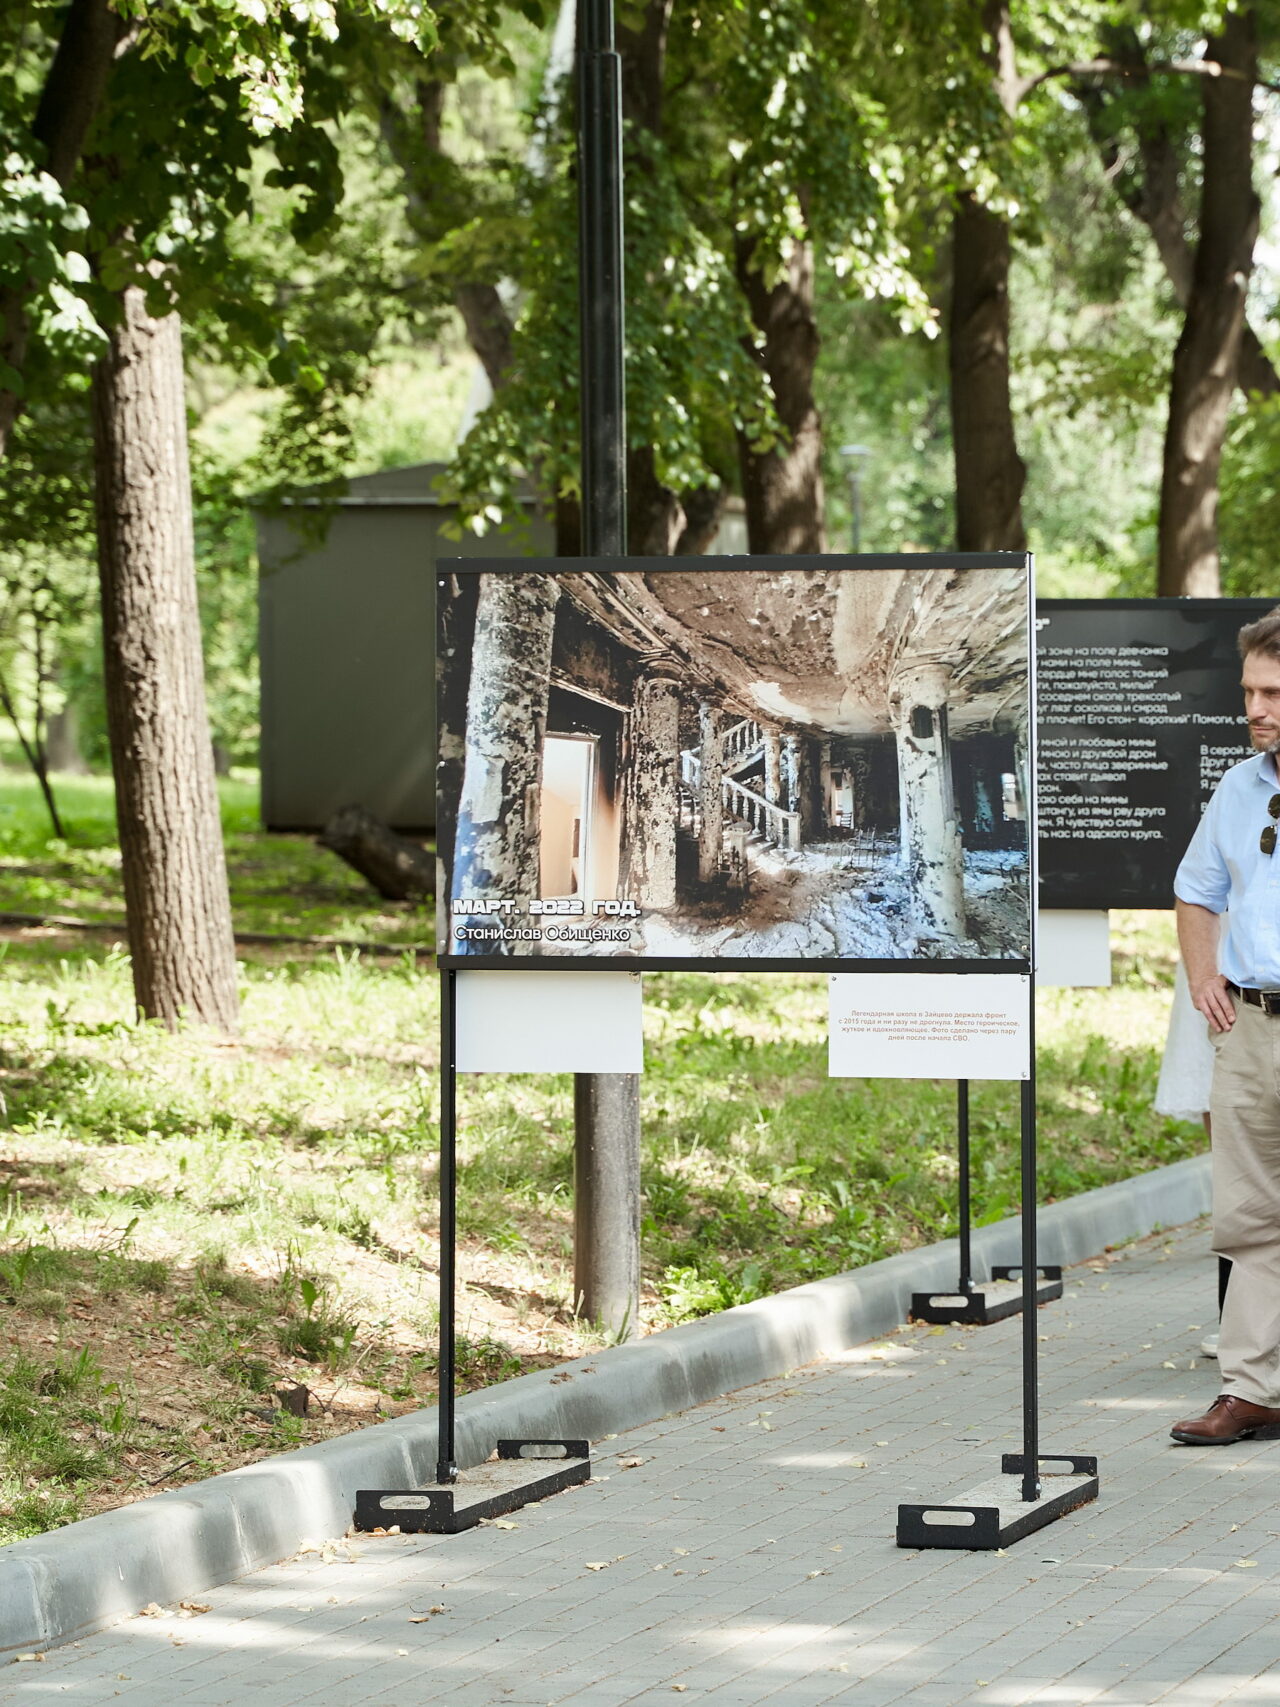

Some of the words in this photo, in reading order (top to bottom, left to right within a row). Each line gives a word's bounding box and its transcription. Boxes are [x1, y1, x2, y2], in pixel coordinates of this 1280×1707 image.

[1048, 647, 1073, 655] зоне
[1075, 647, 1089, 655] на
[1090, 647, 1116, 655] поле
[1118, 647, 1169, 656] девчонка
[1040, 659, 1068, 667] нами
[1070, 659, 1083, 667] на
[1085, 659, 1111, 667] поле
[1113, 659, 1142, 667] мины.
[1100, 670, 1130, 678] голос
[1132, 669, 1169, 678] тонкий
[1053, 681, 1118, 691] пожалуйста,
[1039, 693, 1091, 702] соседнем
[1092, 693, 1124, 701] окопе
[1127, 692, 1181, 702] трехсотый
[1074, 704, 1122, 712] осколков
[1132, 705, 1168, 714] смрад
[1087, 714, 1105, 724] Его
[1192, 714, 1235, 724] Помоги,
[1040, 737, 1068, 747] мной
[1078, 737, 1127, 747] любовью
[1128, 739, 1156, 747] мины
[1041, 750, 1071, 758] мною
[1072, 750, 1079, 758] и
[1081, 749, 1127, 760] дружбой
[1128, 751, 1156, 760] дрон
[1210, 745, 1244, 757] серой
[1050, 761, 1081, 769] часто
[1083, 762, 1109, 770] лица
[1200, 757, 1225, 768] Друг
[1053, 773, 1088, 781] ставит
[1089, 773, 1126, 782] дьявол
[1058, 795, 1083, 804] себя
[1085, 796, 1099, 804] на
[1113, 808, 1132, 817] рву
[1134, 808, 1166, 817] друга
[1056, 817, 1064, 826] Я
[1065, 819, 1114, 828] чувствую
[1115, 819, 1143, 827] силы
[1050, 830, 1071, 838] нас
[1086, 830, 1129, 839] адского
[1130, 831, 1163, 840] круга.
[453, 900, 519, 914] МАРТ.
[529, 900, 584, 915] 2022
[592, 900, 641, 917] ГОД.
[454, 925, 541, 940] Станислав
[545, 926, 631, 942] Обищенко
[851, 1010, 894, 1018] Легендарная
[925, 1011, 952, 1019] Зайцево
